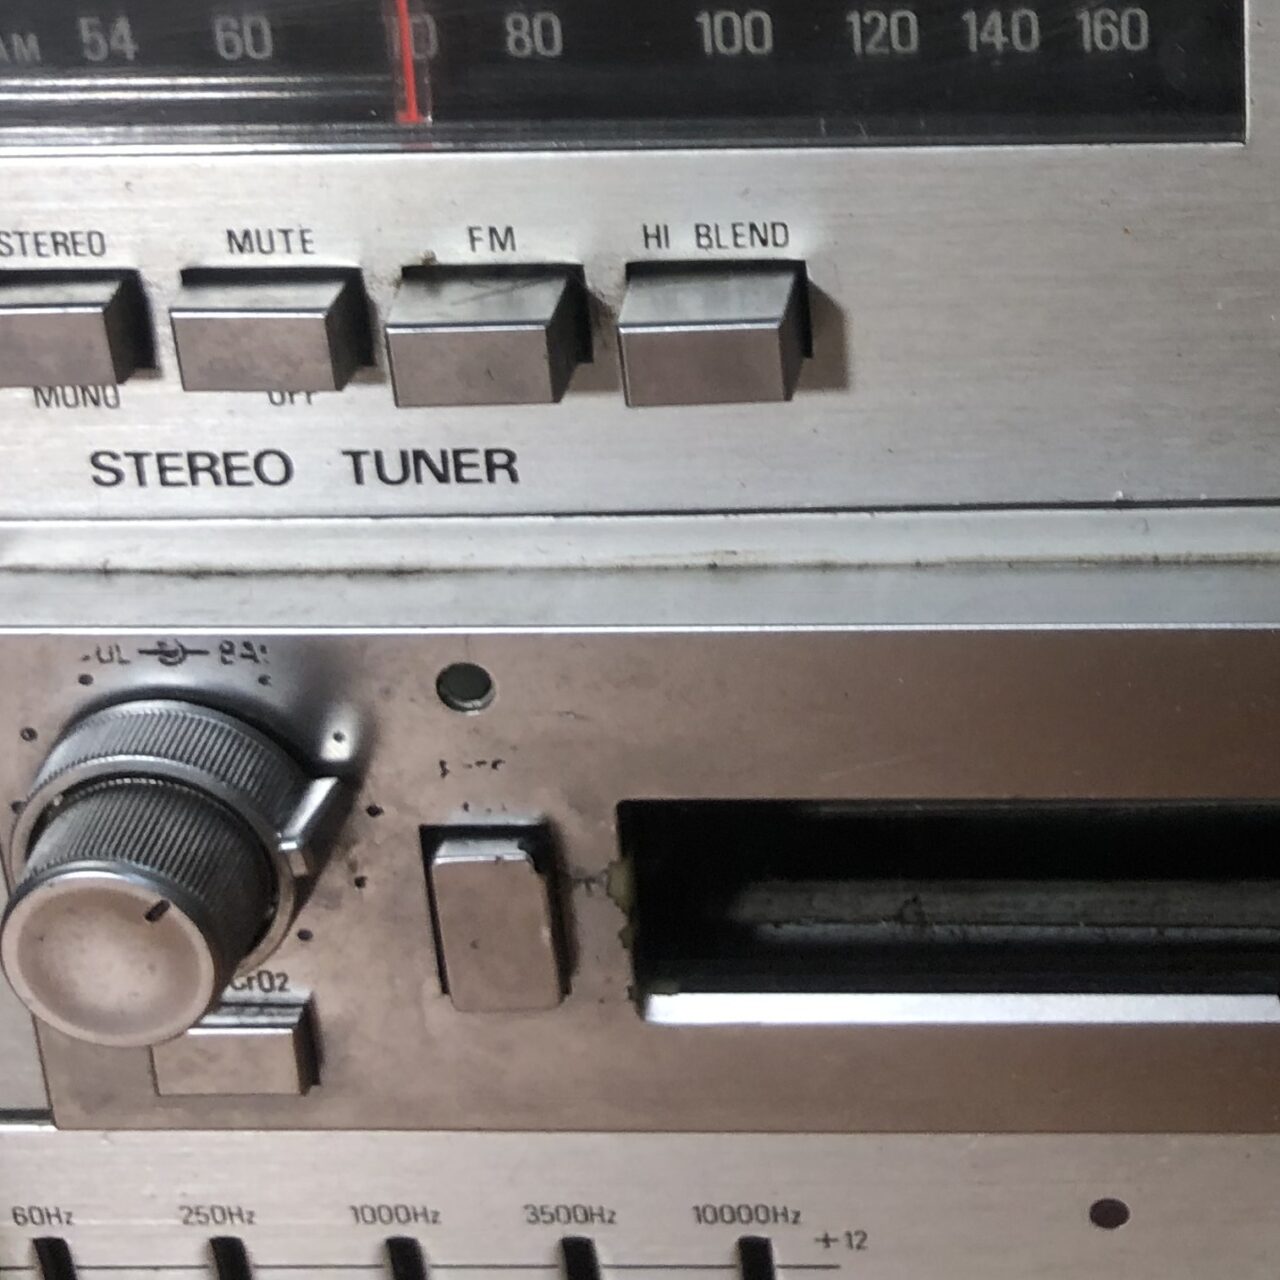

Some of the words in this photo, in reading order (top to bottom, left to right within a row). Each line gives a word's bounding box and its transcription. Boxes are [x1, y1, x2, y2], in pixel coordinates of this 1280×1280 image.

[79, 17, 139, 62] 54
[213, 17, 273, 61] 60
[505, 12, 563, 57] 80
[696, 11, 774, 56] 100
[846, 10, 918, 55] 120
[962, 8, 1040, 54] 140
[1075, 7, 1149, 52] 160
[0, 230, 107, 258] STEREO
[226, 227, 316, 255] MUTE
[468, 226, 516, 253] FM
[643, 224, 671, 250] HI
[694, 221, 790, 249] BLEND
[33, 384, 120, 410] MONO
[91, 450, 294, 487] STEREO
[342, 448, 519, 485] TUNER
[12, 1206, 73, 1227] 60Hz
[179, 1206, 256, 1227] 250Hz
[350, 1205, 441, 1226] 1000Hz
[524, 1205, 617, 1226] 3500Hz
[692, 1204, 801, 1225] 10000Hz
